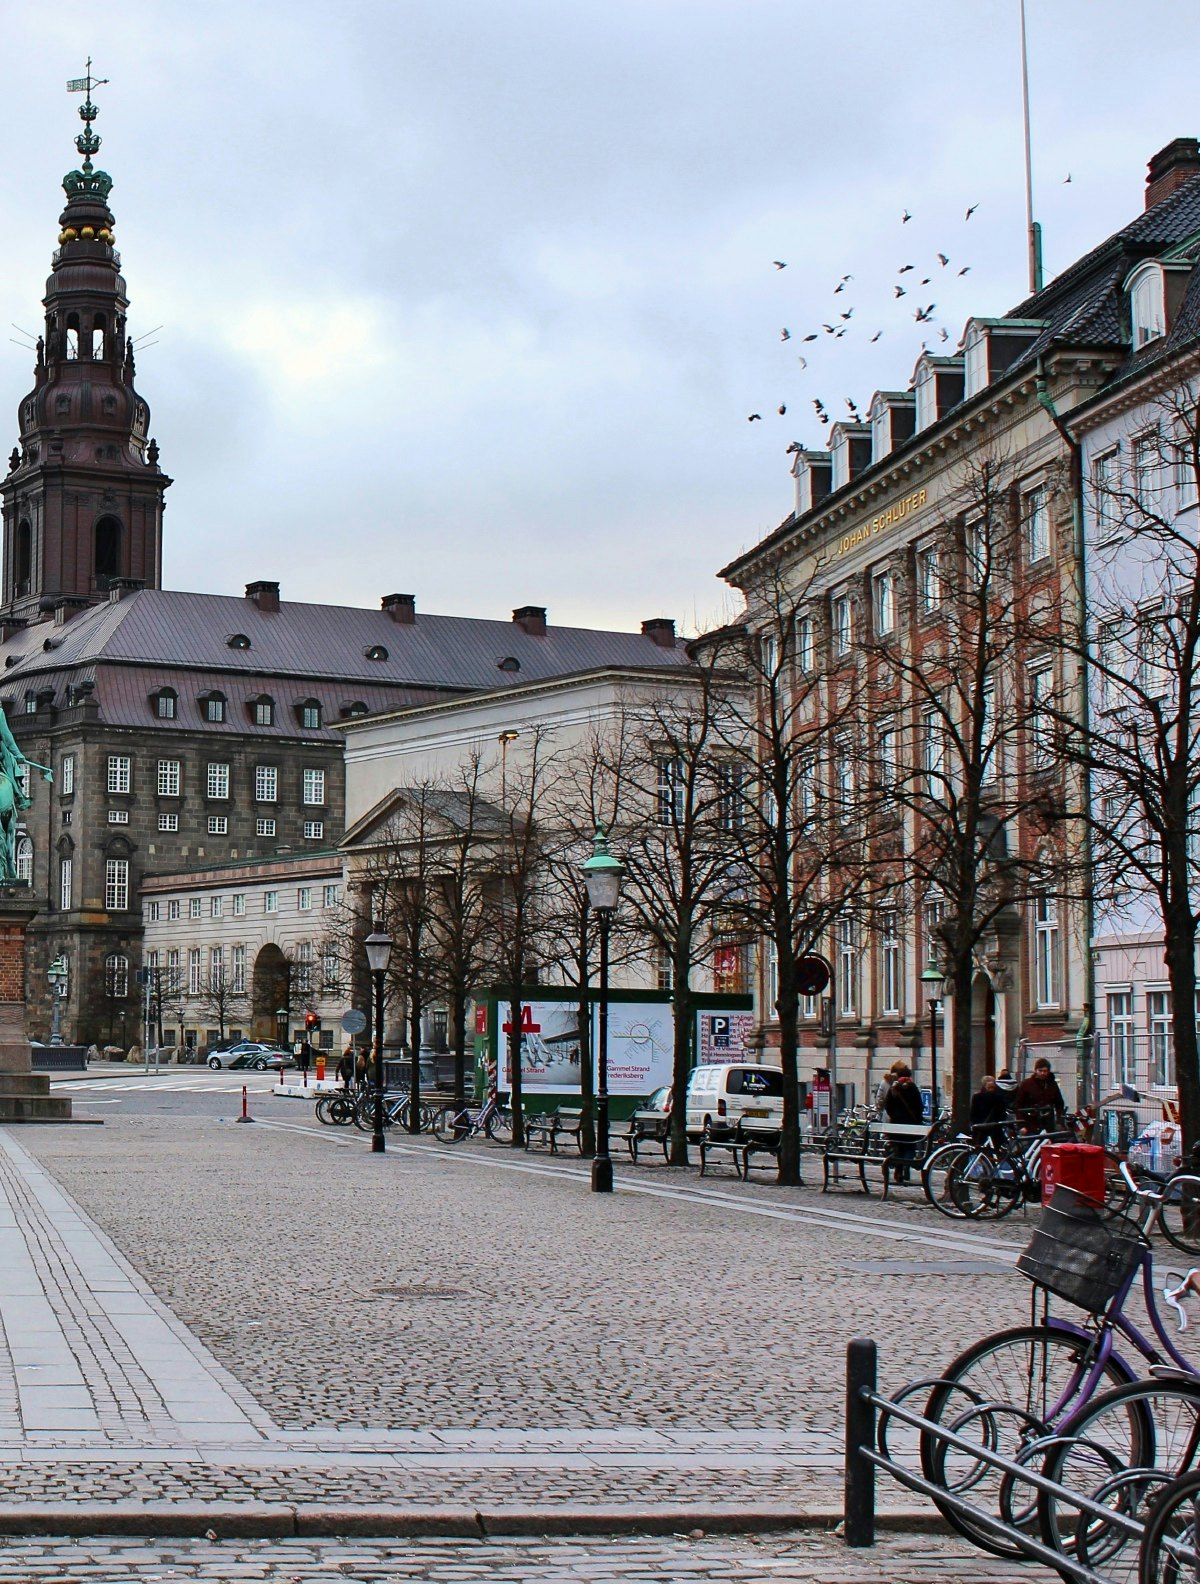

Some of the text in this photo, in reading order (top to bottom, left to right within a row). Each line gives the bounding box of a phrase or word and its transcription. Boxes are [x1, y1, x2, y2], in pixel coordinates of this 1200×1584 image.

[838, 489, 927, 554] JOHAN SCHLÜTER
[714, 1018, 726, 1034] P
